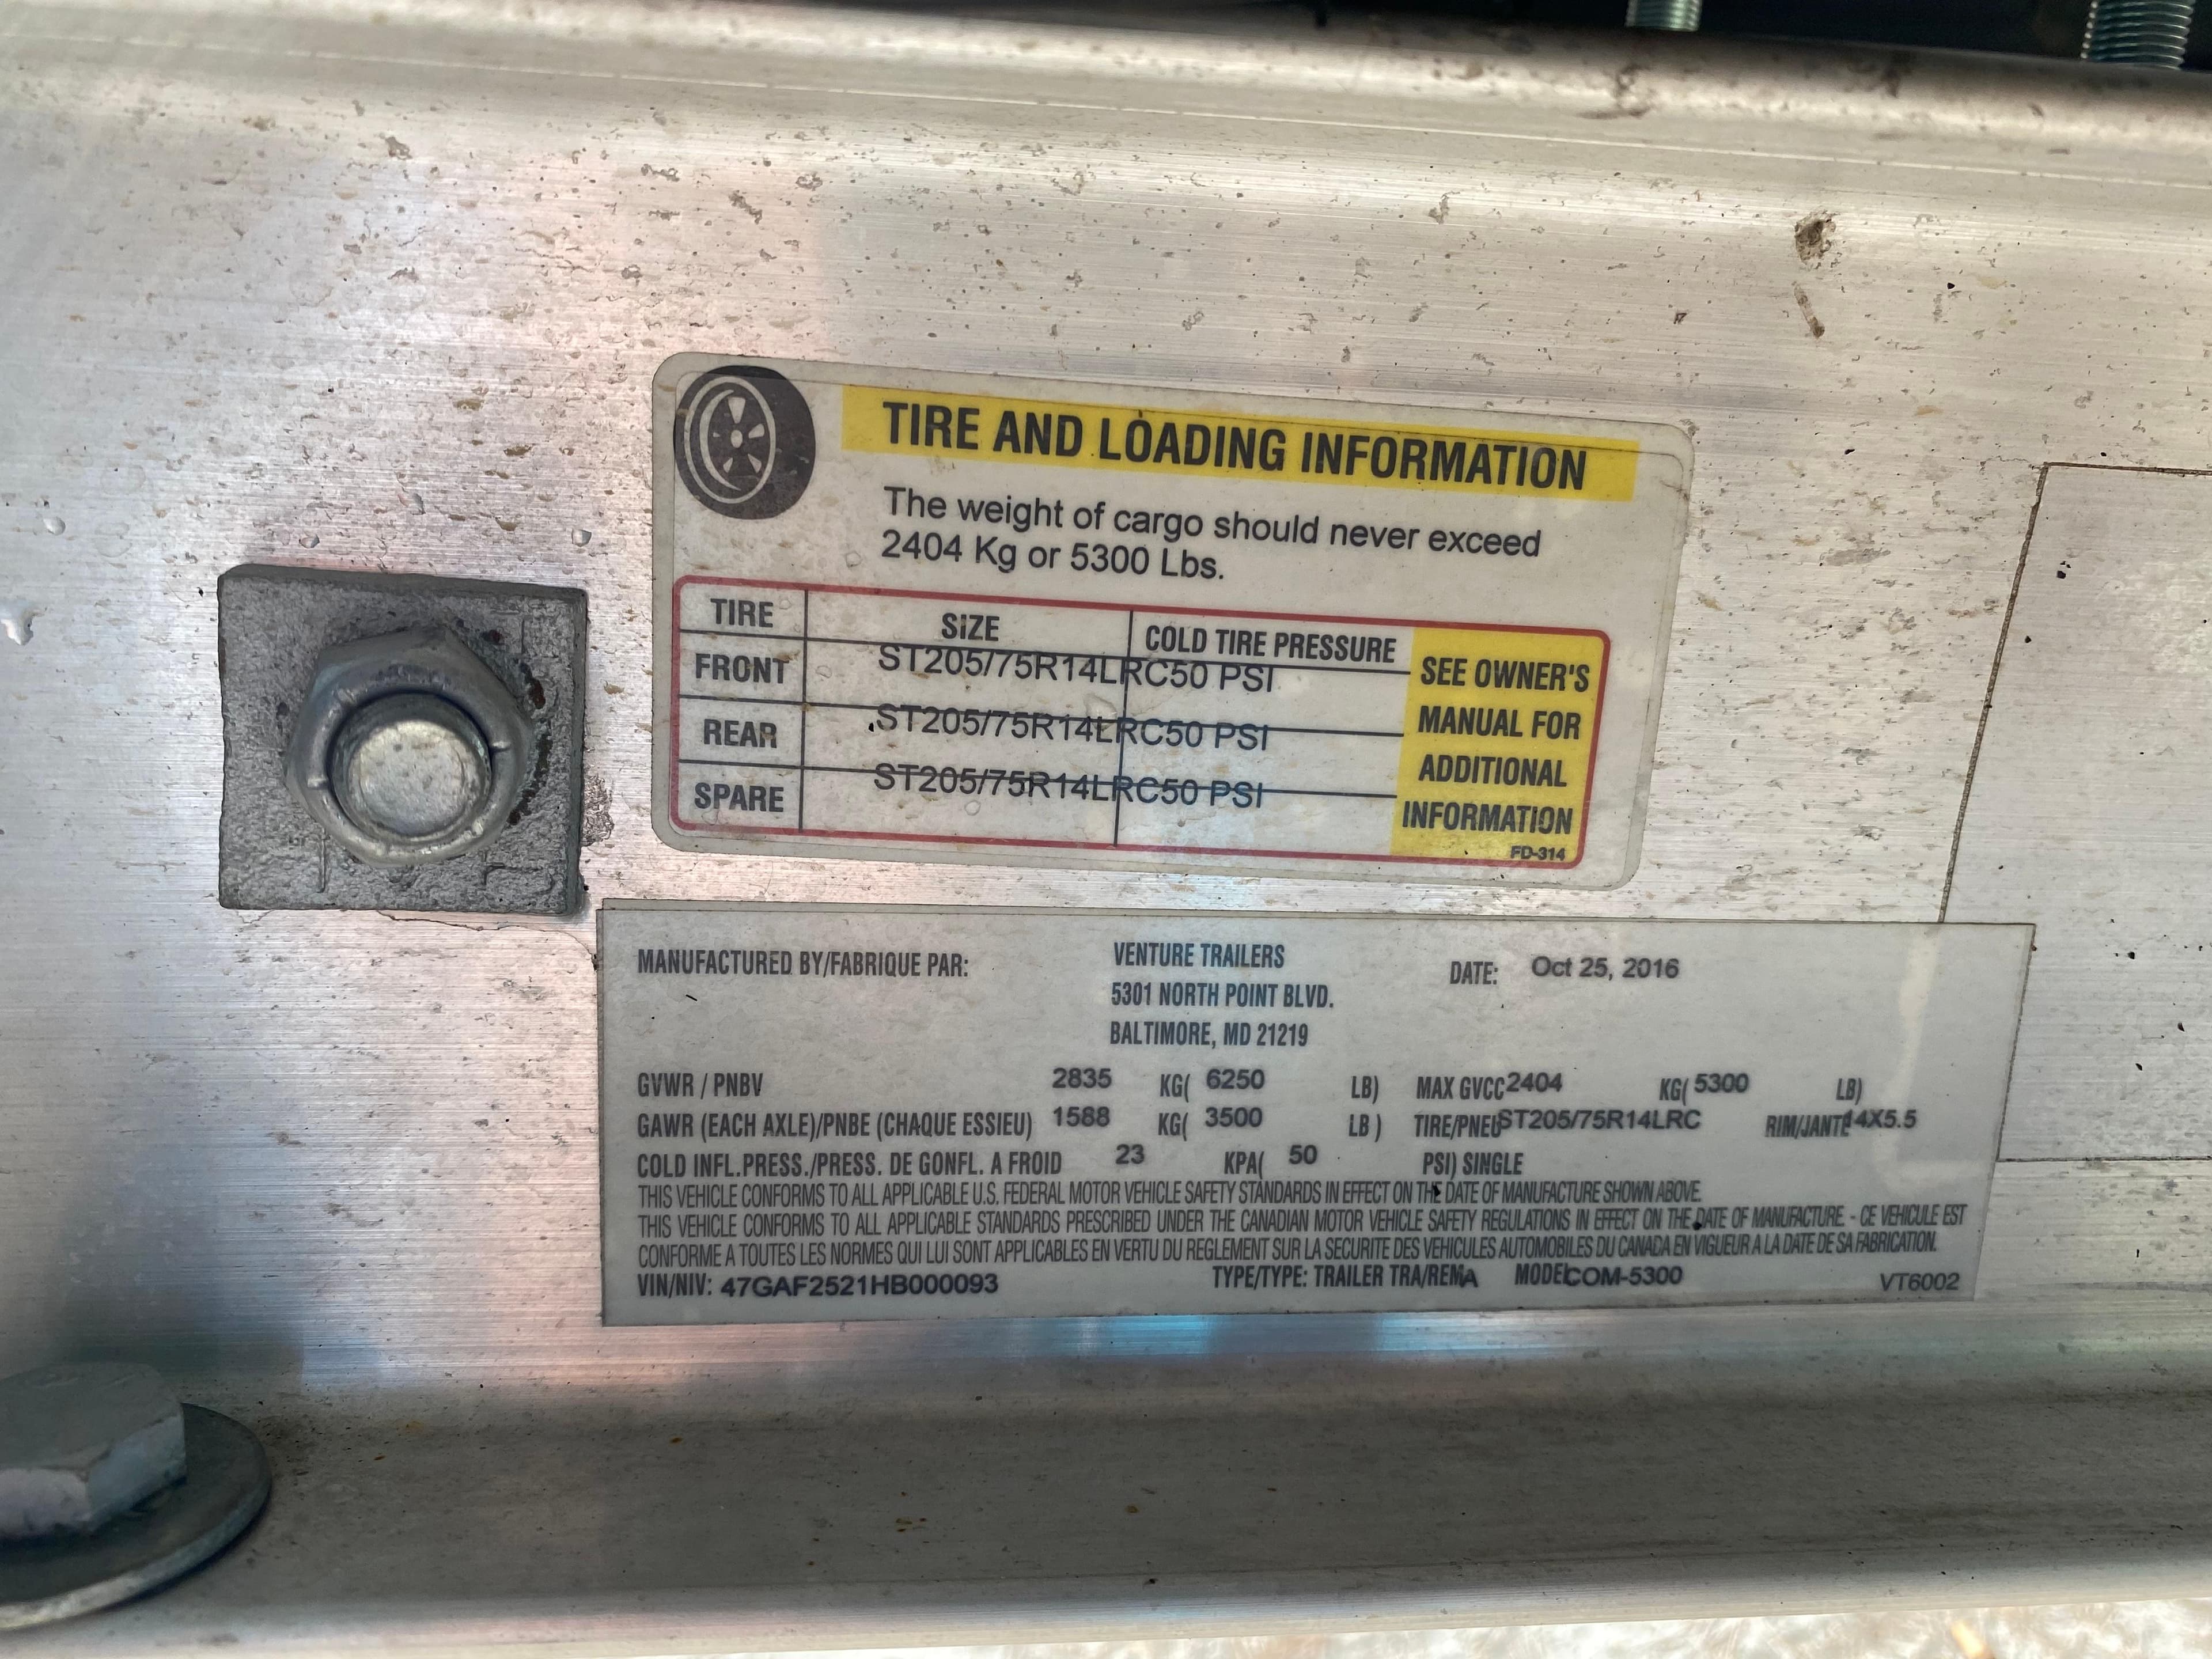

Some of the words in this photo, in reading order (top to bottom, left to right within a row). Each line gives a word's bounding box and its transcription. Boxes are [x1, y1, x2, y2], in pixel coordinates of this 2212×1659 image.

[882, 402, 980, 449] TIRE
[993, 410, 1083, 457] AND
[1099, 416, 1286, 471] LOADING
[1301, 432, 1588, 490] INFORMATION
[883, 486, 947, 518] The
[957, 495, 1063, 534] weight
[1073, 502, 1107, 528] of
[1113, 508, 1203, 543] cargo
[1214, 510, 1318, 544] should
[1330, 522, 1419, 551] never
[1428, 529, 1541, 557] exceed
[881, 529, 962, 562] 2404
[976, 537, 1017, 573] Kg
[1028, 545, 1060, 569] or
[1070, 543, 1150, 575] 5300
[1161, 548, 1225, 580] Lbs.
[710, 598, 774, 628] TIRE
[942, 613, 1000, 642] SIZE
[1146, 626, 1207, 653] COLD
[1215, 629, 1267, 657] TIRE
[1274, 632, 1396, 663] PRESSURE
[695, 653, 790, 684] FRONT
[1220, 664, 1274, 692] PSI
[1421, 657, 1468, 686] SEE
[1475, 658, 1590, 692] OWNER'S
[703, 718, 777, 748] REAR
[1214, 722, 1267, 751] PSI
[1418, 705, 1523, 737] MANUAL
[1531, 710, 1581, 740] FOR
[1418, 754, 1567, 787] ADDITIONAL
[694, 782, 784, 813] SPARE
[1210, 780, 1263, 809] PSI
[1402, 801, 1573, 834] INFORMATION
[1510, 845, 1566, 861] FD-314
[637, 949, 792, 975] MANUFACTURED
[800, 951, 921, 978] BY/FABRIQUE
[927, 953, 968, 978] PAR:
[1113, 942, 1194, 967] VENTURE
[1200, 943, 1285, 968] TRAILERS
[1450, 960, 1498, 985] DATE:
[1532, 955, 1572, 978] Oct
[1579, 957, 1613, 980] 25,
[1622, 957, 1680, 979] 2016
[1111, 982, 1152, 1006] 5301
[1159, 983, 1218, 1007] NORTH
[1225, 984, 1278, 1008] POINT
[1283, 984, 1334, 1009] BLVD.
[1109, 1021, 1216, 1049] BALTIMORE,
[1224, 1022, 1251, 1046] MD
[1257, 1023, 1309, 1047] 21219
[638, 1072, 694, 1097] GVWR
[714, 1072, 763, 1097] PNBV
[1052, 1067, 1112, 1089] 2835
[1206, 1069, 1265, 1090] 6250
[1416, 1075, 1455, 1100] MAX
[1460, 1077, 1504, 1100] GVCC
[1506, 1072, 1562, 1093] 2404
[1694, 1073, 1749, 1093] 5300
[638, 1112, 694, 1138] GAWR
[701, 1112, 756, 1142] (EACH
[763, 1112, 870, 1142] AXLE)/PNBE
[876, 1112, 956, 1141] (CHAQUE
[963, 1112, 1033, 1141] ESSIEU)
[1053, 1106, 1111, 1127] 1588
[1205, 1107, 1263, 1128] 3500
[1498, 1109, 1701, 1131] ST205/75R14LRC
[638, 1153, 686, 1178] COLD
[889, 1152, 912, 1176] DE
[919, 1151, 983, 1176] GONFL.
[991, 1152, 1002, 1175] A
[1008, 1152, 1062, 1175] FROID
[1116, 1144, 1145, 1165] 23
[1289, 1145, 1318, 1165] 50
[1462, 1152, 1524, 1176] SINGLE
[638, 1184, 672, 1209] THIS
[677, 1184, 737, 1209] VEHICLE
[741, 1183, 825, 1208] CONFORMS
[829, 1183, 848, 1207] TO
[851, 1182, 878, 1206] ALL
[882, 1181, 968, 1206] APPLICABLE
[973, 1181, 999, 1205] U.S.
[1004, 1181, 1065, 1205] FEDERAL
[1069, 1181, 1120, 1205] MOTOR
[1124, 1181, 1181, 1204] VEHICLE
[1185, 1181, 1236, 1204] SAFETY
[1238, 1181, 1321, 1204] STANDARDS
[1342, 1181, 1391, 1204] EFFECT
[1393, 1181, 1412, 1204] ON
[1445, 1181, 1479, 1204] DATE
[1502, 1180, 1601, 1203] MANUFACTURE
[1603, 1180, 1654, 1203] SHOWN
[1656, 1180, 1701, 1202] ABOVE.
[638, 1214, 671, 1238] THIS
[677, 1214, 737, 1238] VEHICLE
[743, 1213, 824, 1238] CONFORMS
[831, 1213, 849, 1236] TO
[855, 1212, 881, 1236] ALL
[887, 1211, 971, 1236] APPLICABLE
[977, 1210, 1060, 1234] STANDARDS
[1066, 1210, 1150, 1234] PRESCRIBED
[1157, 1210, 1204, 1233] UNDER
[1211, 1210, 1235, 1233] THE
[1240, 1209, 1308, 1232] CANADIAN
[1314, 1209, 1363, 1232] MOTOR
[1370, 1209, 1423, 1232] VEHICLE
[1427, 1209, 1478, 1232] SAFETY
[1481, 1209, 1570, 1232] REGULATIONS
[1752, 1205, 1845, 1228] MANUFACTURE.
[1881, 1205, 1940, 1226] VEHICULE
[1942, 1204, 1968, 1226] EST
[638, 1244, 721, 1268] CONFORME
[740, 1243, 796, 1267] TOUTES
[800, 1243, 826, 1266] LES
[831, 1241, 892, 1266] NORMES
[897, 1241, 922, 1265] QUI
[953, 1240, 992, 1264] SONT
[995, 1239, 1088, 1263] APPLICABLES
[1114, 1238, 1158, 1262] VERTU
[1186, 1238, 1270, 1261] REGLEMENT
[1272, 1237, 1301, 1260] SUR
[1325, 1237, 1390, 1260] SECURITE
[1393, 1237, 1420, 1260] DES
[1424, 1237, 1496, 1259] VEHICULES
[1499, 1236, 1593, 1259] AUTOMOBILES
[1618, 1234, 1671, 1256] CANADA
[1694, 1233, 1749, 1256] VIGUEUR
[1783, 1232, 1815, 1254] DATE
[1855, 1231, 1937, 1252] FABRICATION.
[637, 1272, 712, 1298] VIN/NIV:
[720, 1274, 999, 1297] 47GAF2521HB000093
[1213, 1264, 1308, 1290] TYPE/TYPE:
[1315, 1264, 1383, 1287] TRAILER
[1880, 1272, 1960, 1291] VT6002
